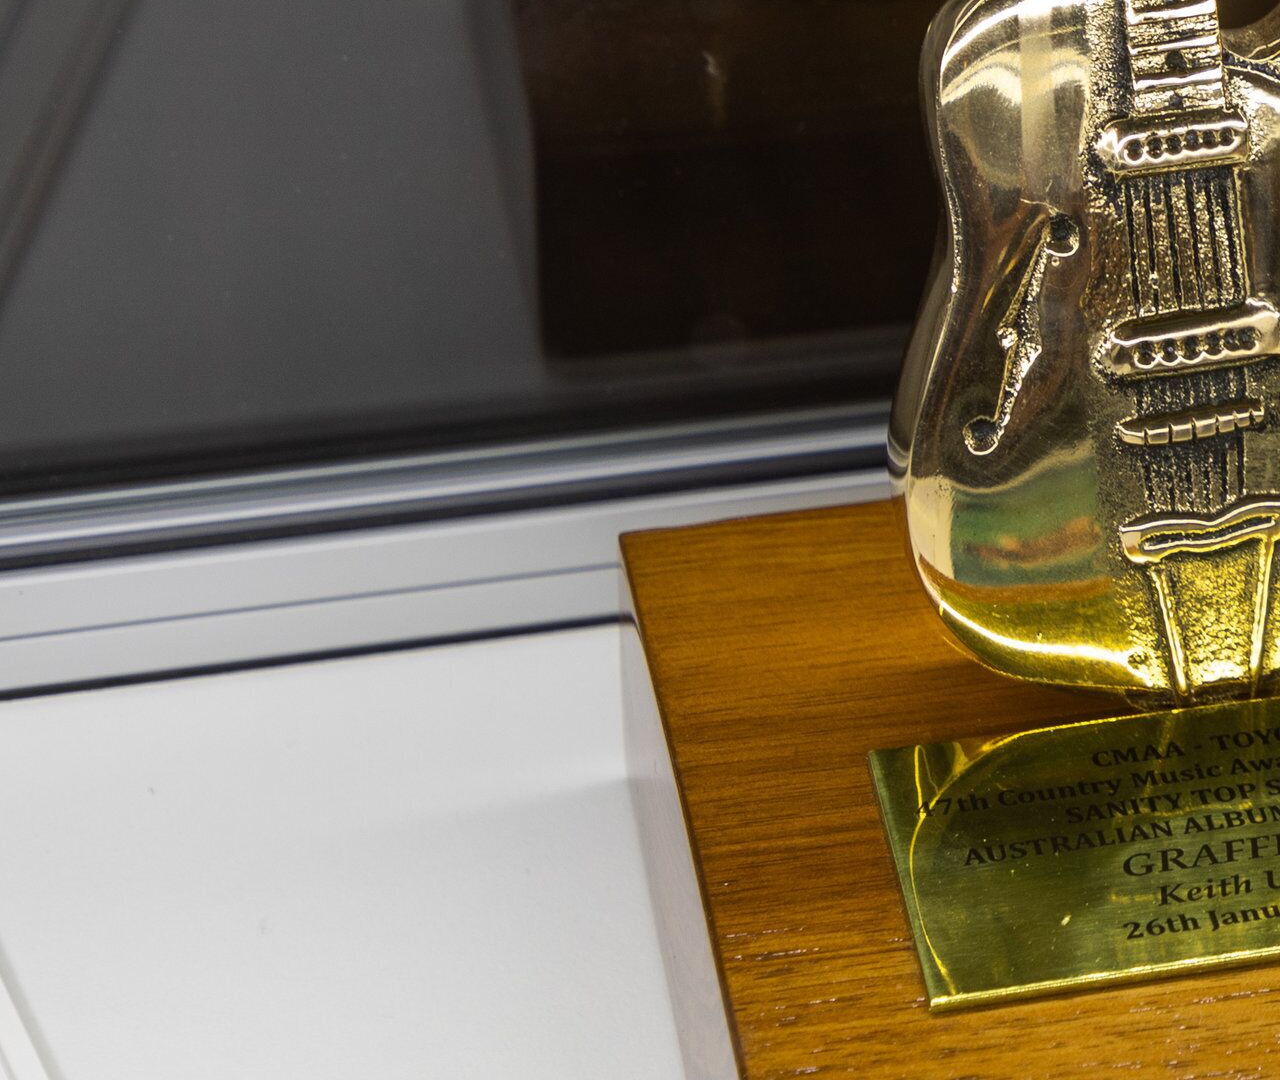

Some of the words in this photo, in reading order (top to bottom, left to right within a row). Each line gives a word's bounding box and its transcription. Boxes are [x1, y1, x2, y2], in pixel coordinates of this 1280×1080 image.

[1092, 743, 1185, 768] CMAA
[916, 792, 990, 818] 47th
[998, 777, 1122, 807] Country
[1131, 761, 1221, 789] Music
[1065, 792, 1181, 825] SANITY
[1190, 781, 1257, 805] TOP
[964, 820, 1172, 867] AUSTRALIAN
[1157, 874, 1253, 907] Keith
[1122, 912, 1201, 940] 26th
